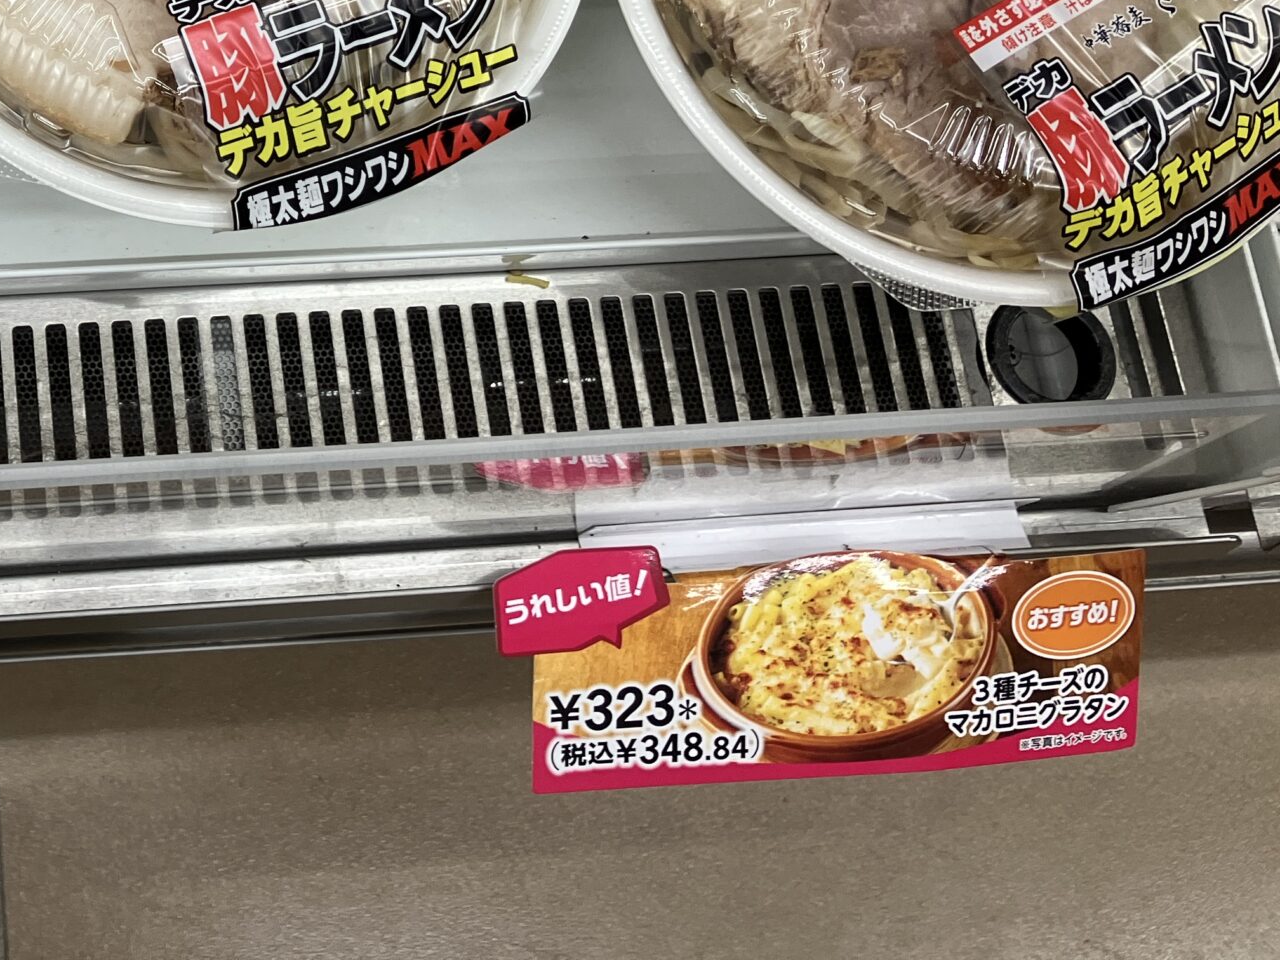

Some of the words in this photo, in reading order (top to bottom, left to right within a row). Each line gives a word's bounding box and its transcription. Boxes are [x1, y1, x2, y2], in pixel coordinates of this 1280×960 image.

[1001, 12, 1057, 52] 傾け注意
[1082, 5, 1152, 51] 中華蕎麦
[1003, 58, 1073, 114] デカ
[218, 44, 519, 179] デカ旨チャーシュー
[247, 107, 514, 228] 極太麺ワシワシMAX
[1084, 160, 1280, 305] 極太麺ワシワシMA
[504, 569, 648, 625] うれしい値!
[1027, 599, 1119, 631] おすすめ!
[975, 667, 1106, 703] 3種チーズの
[948, 697, 1126, 734] マカロニグラタン
[550, 729, 761, 770] (税込¥348.84)
